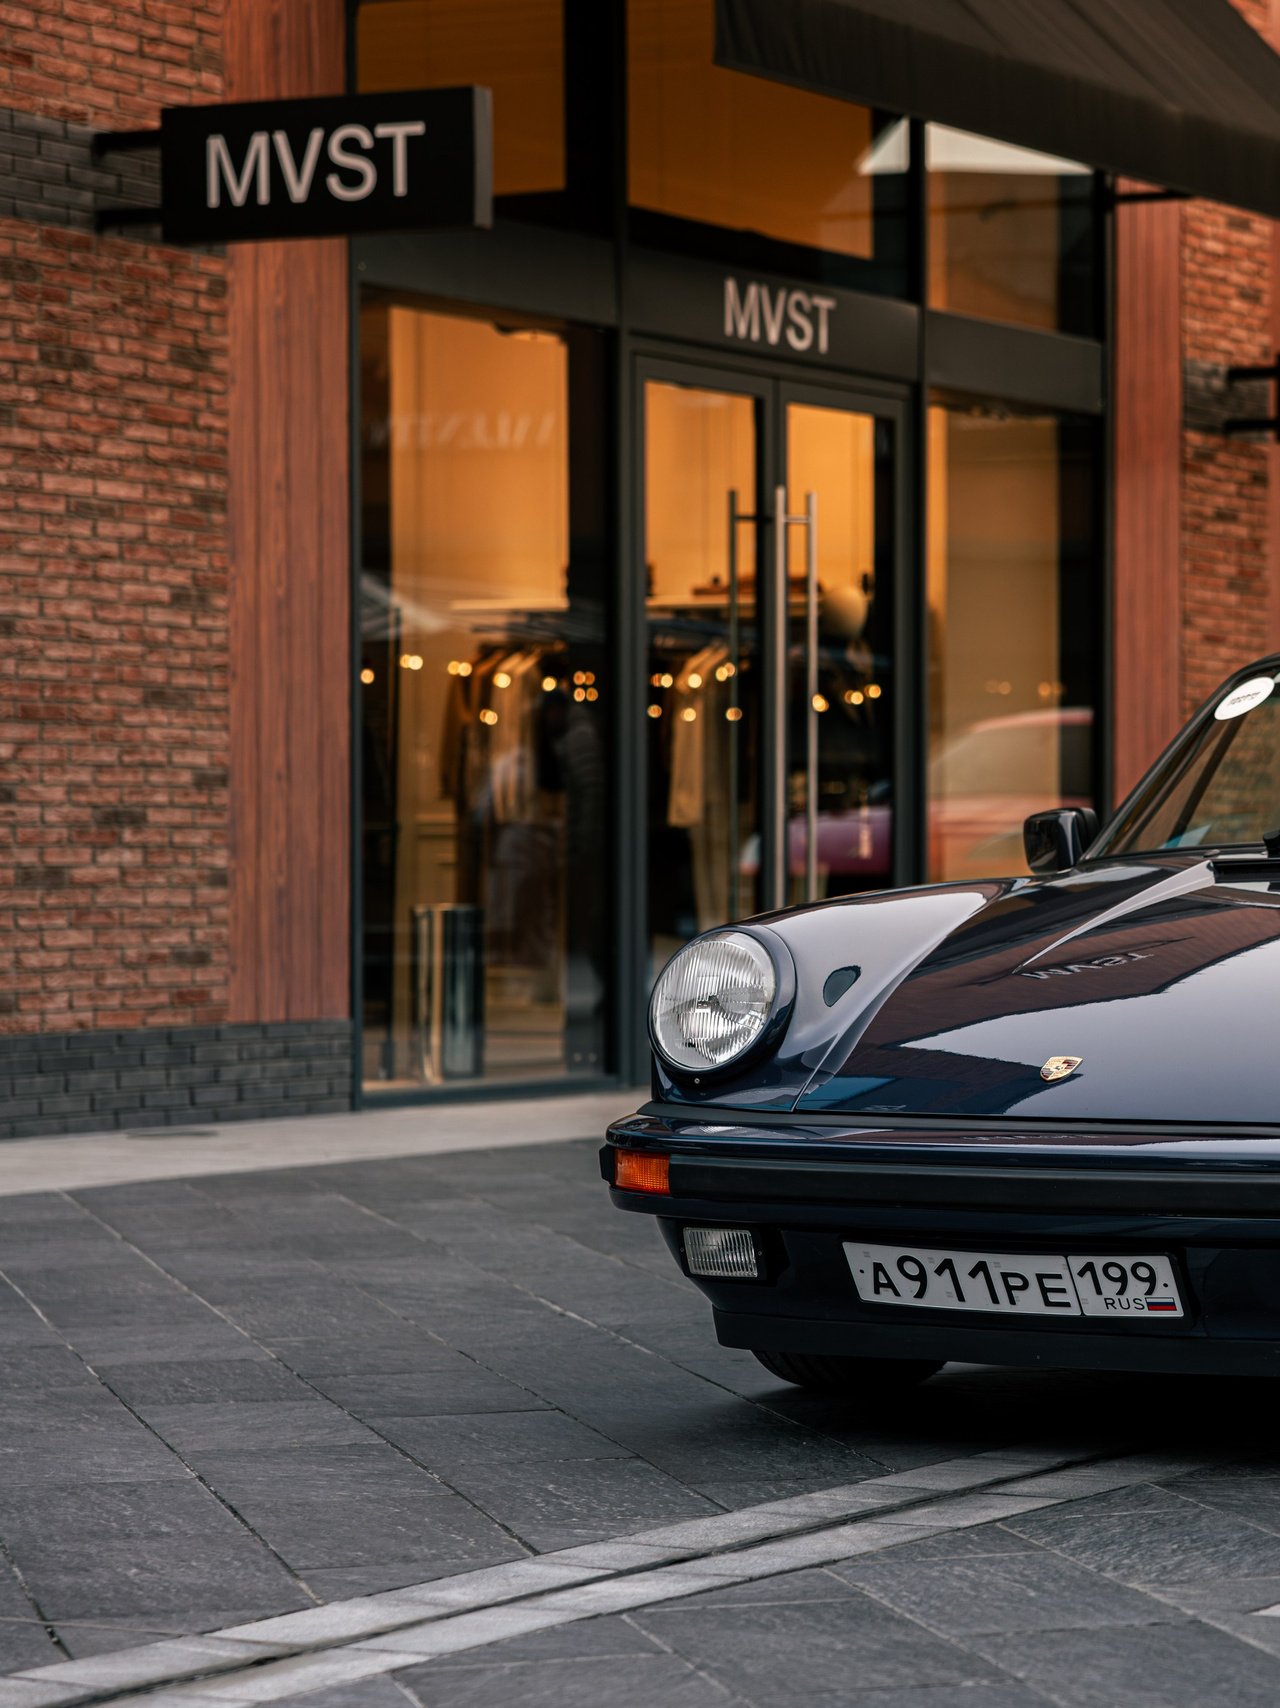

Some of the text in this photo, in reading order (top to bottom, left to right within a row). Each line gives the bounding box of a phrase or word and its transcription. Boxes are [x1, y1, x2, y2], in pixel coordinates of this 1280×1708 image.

[206, 120, 426, 208] MVST
[724, 276, 837, 354] MVST
[872, 1254, 1157, 1308] A911PE 199
[1106, 1298, 1146, 1311] RUS
